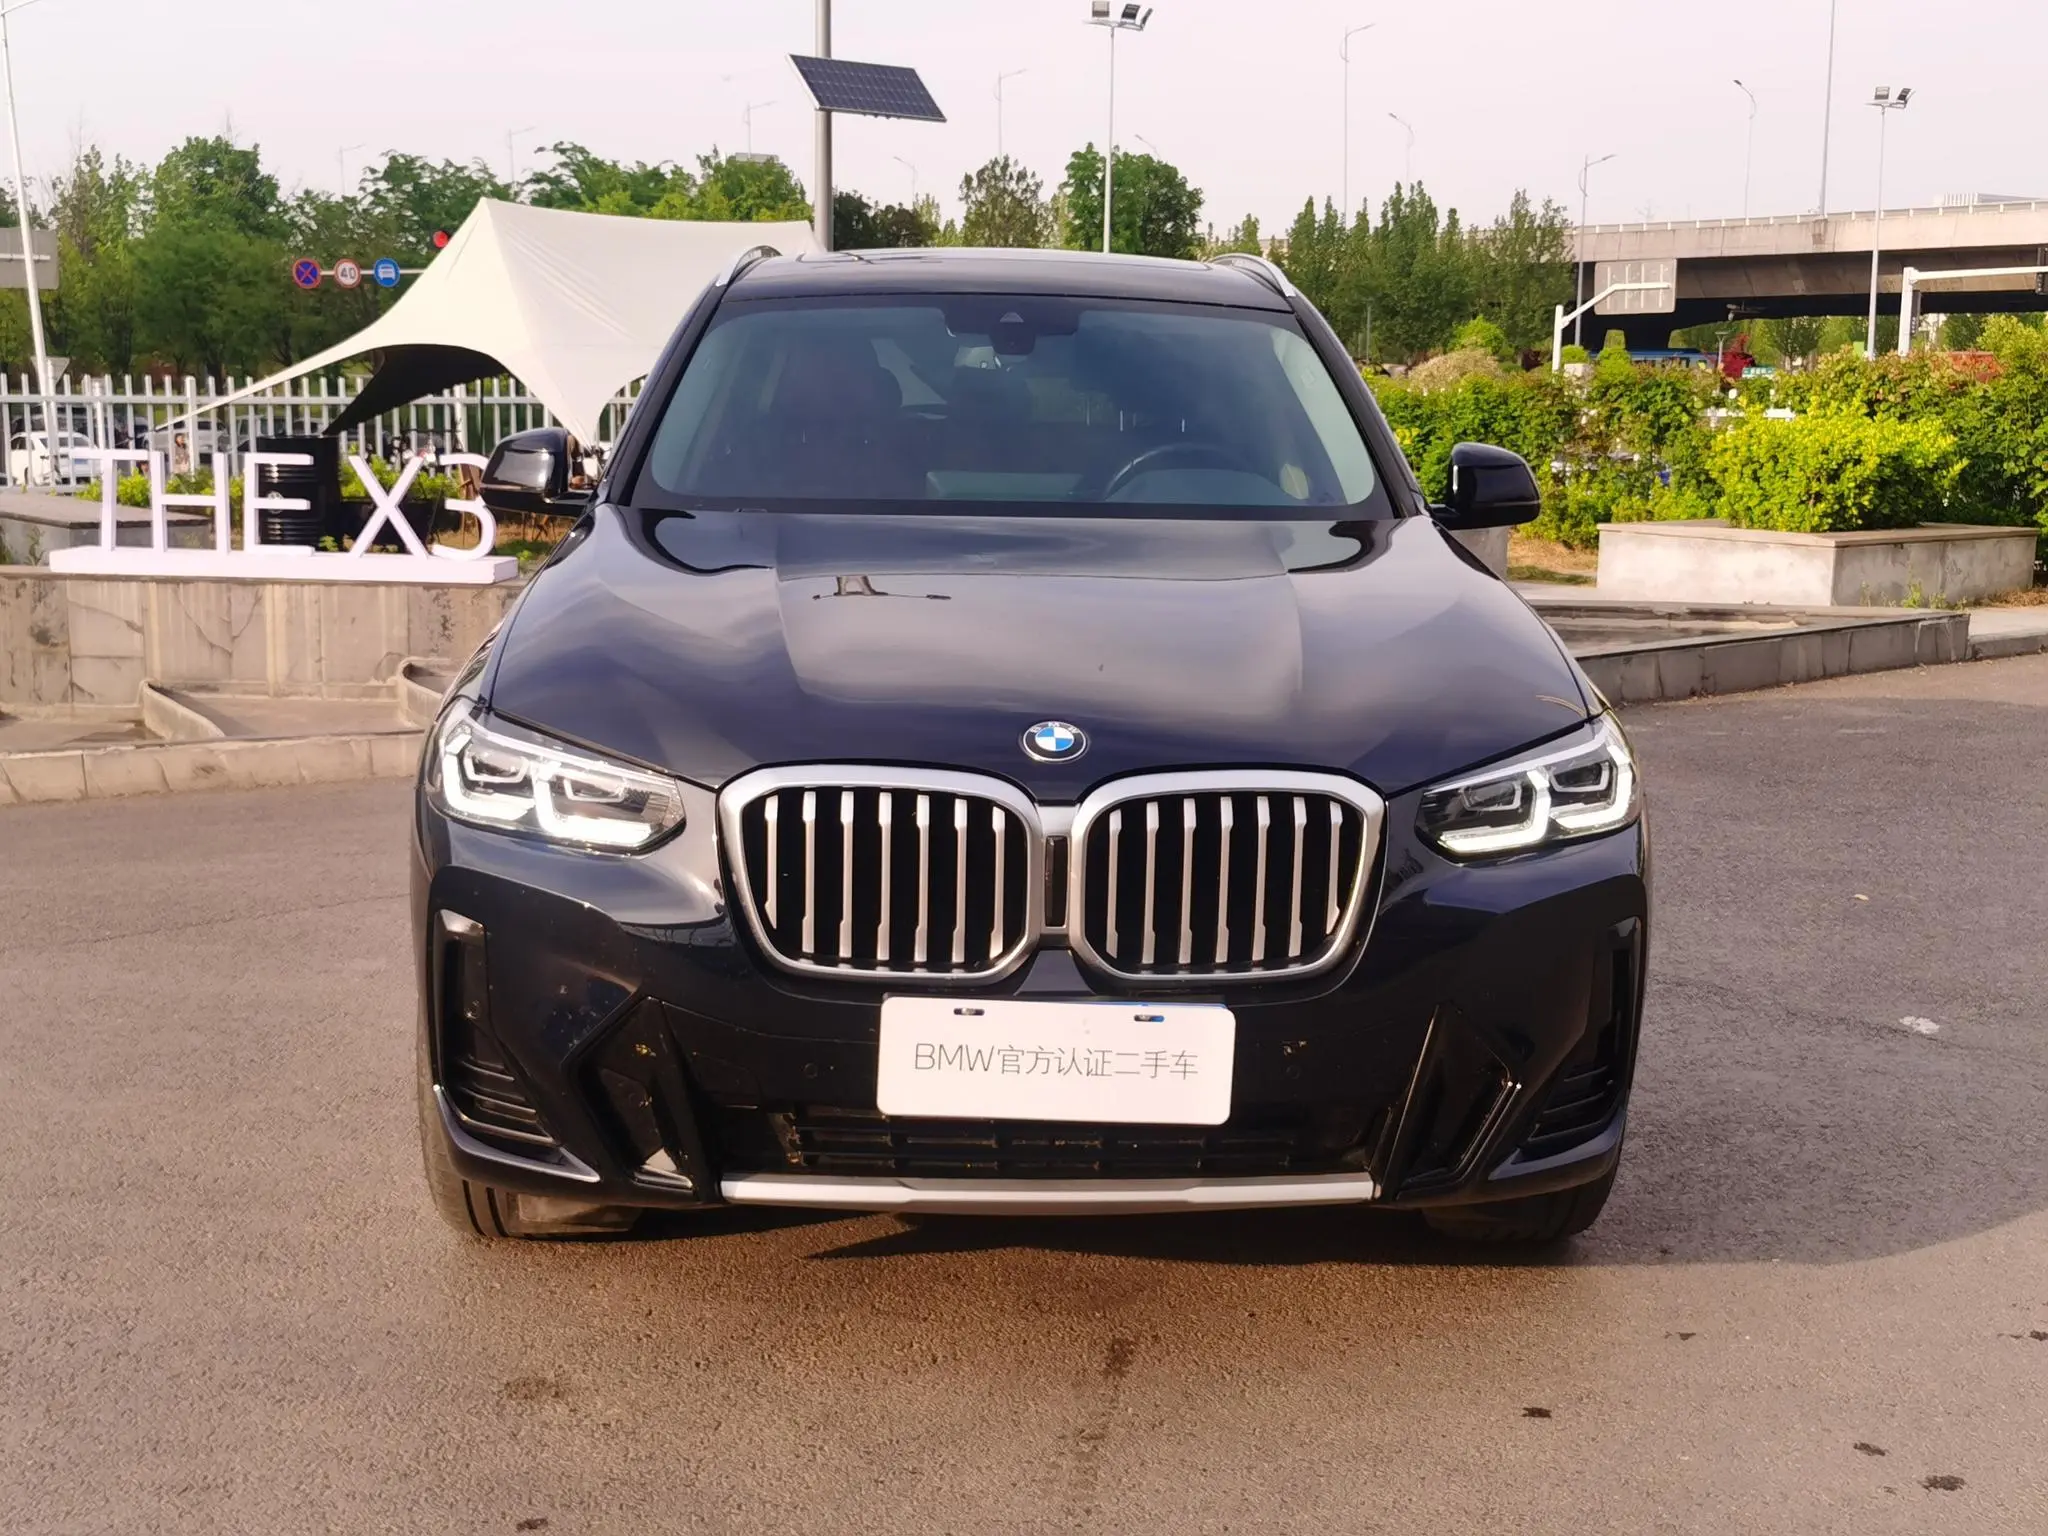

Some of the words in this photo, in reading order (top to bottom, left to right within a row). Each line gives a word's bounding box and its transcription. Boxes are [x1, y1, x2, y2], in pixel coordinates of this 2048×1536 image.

[340, 267, 357, 280] 40
[70, 449, 314, 556] THE
[348, 454, 497, 560] X3
[914, 1043, 1199, 1080] BMW官方认证二手车
